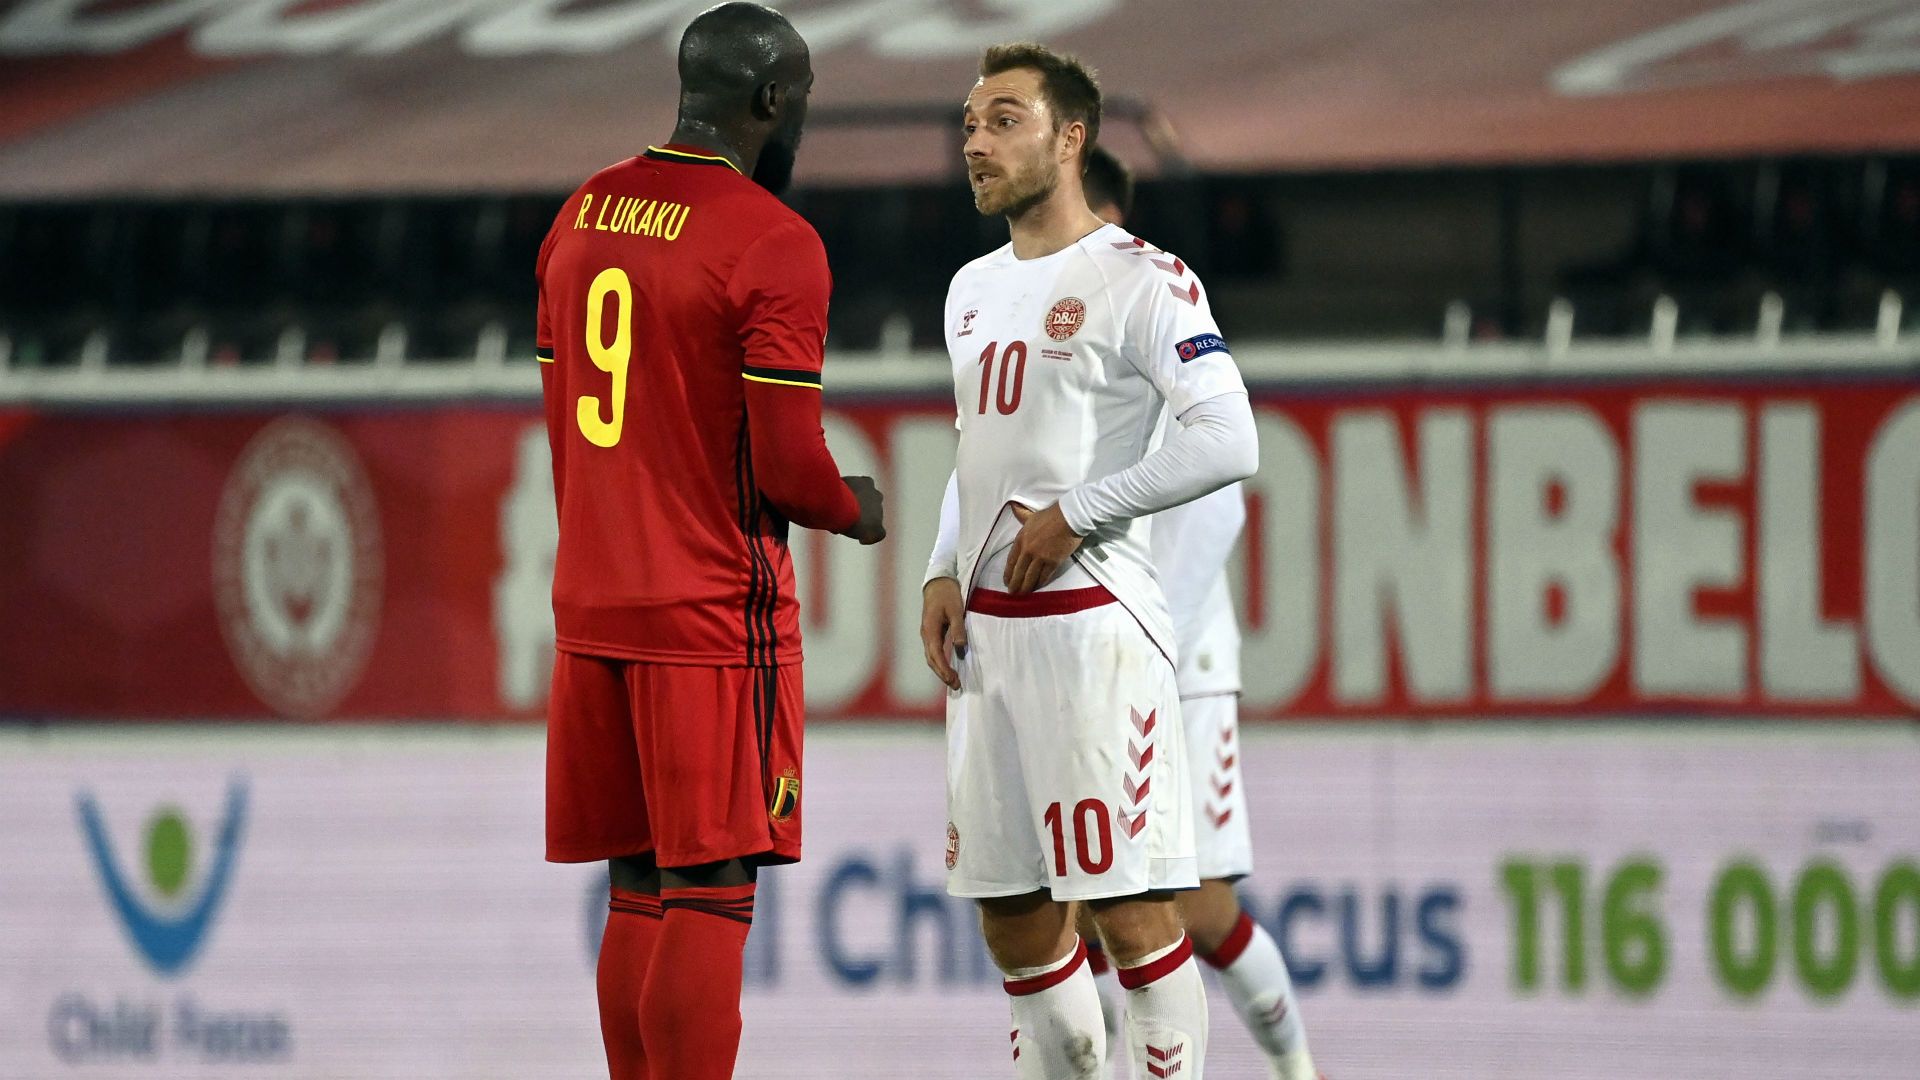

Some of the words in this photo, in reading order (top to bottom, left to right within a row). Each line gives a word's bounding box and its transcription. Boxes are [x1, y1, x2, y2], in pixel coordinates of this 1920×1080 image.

[573, 193, 593, 230] R.
[595, 194, 691, 241] LUKAKU
[1052, 311, 1077, 325] DBU
[576, 267, 633, 448] 9
[978, 340, 1027, 416] 10
[1044, 798, 1114, 877] 10
[1502, 858, 1669, 993] 116
[1710, 858, 1920, 997] 000
